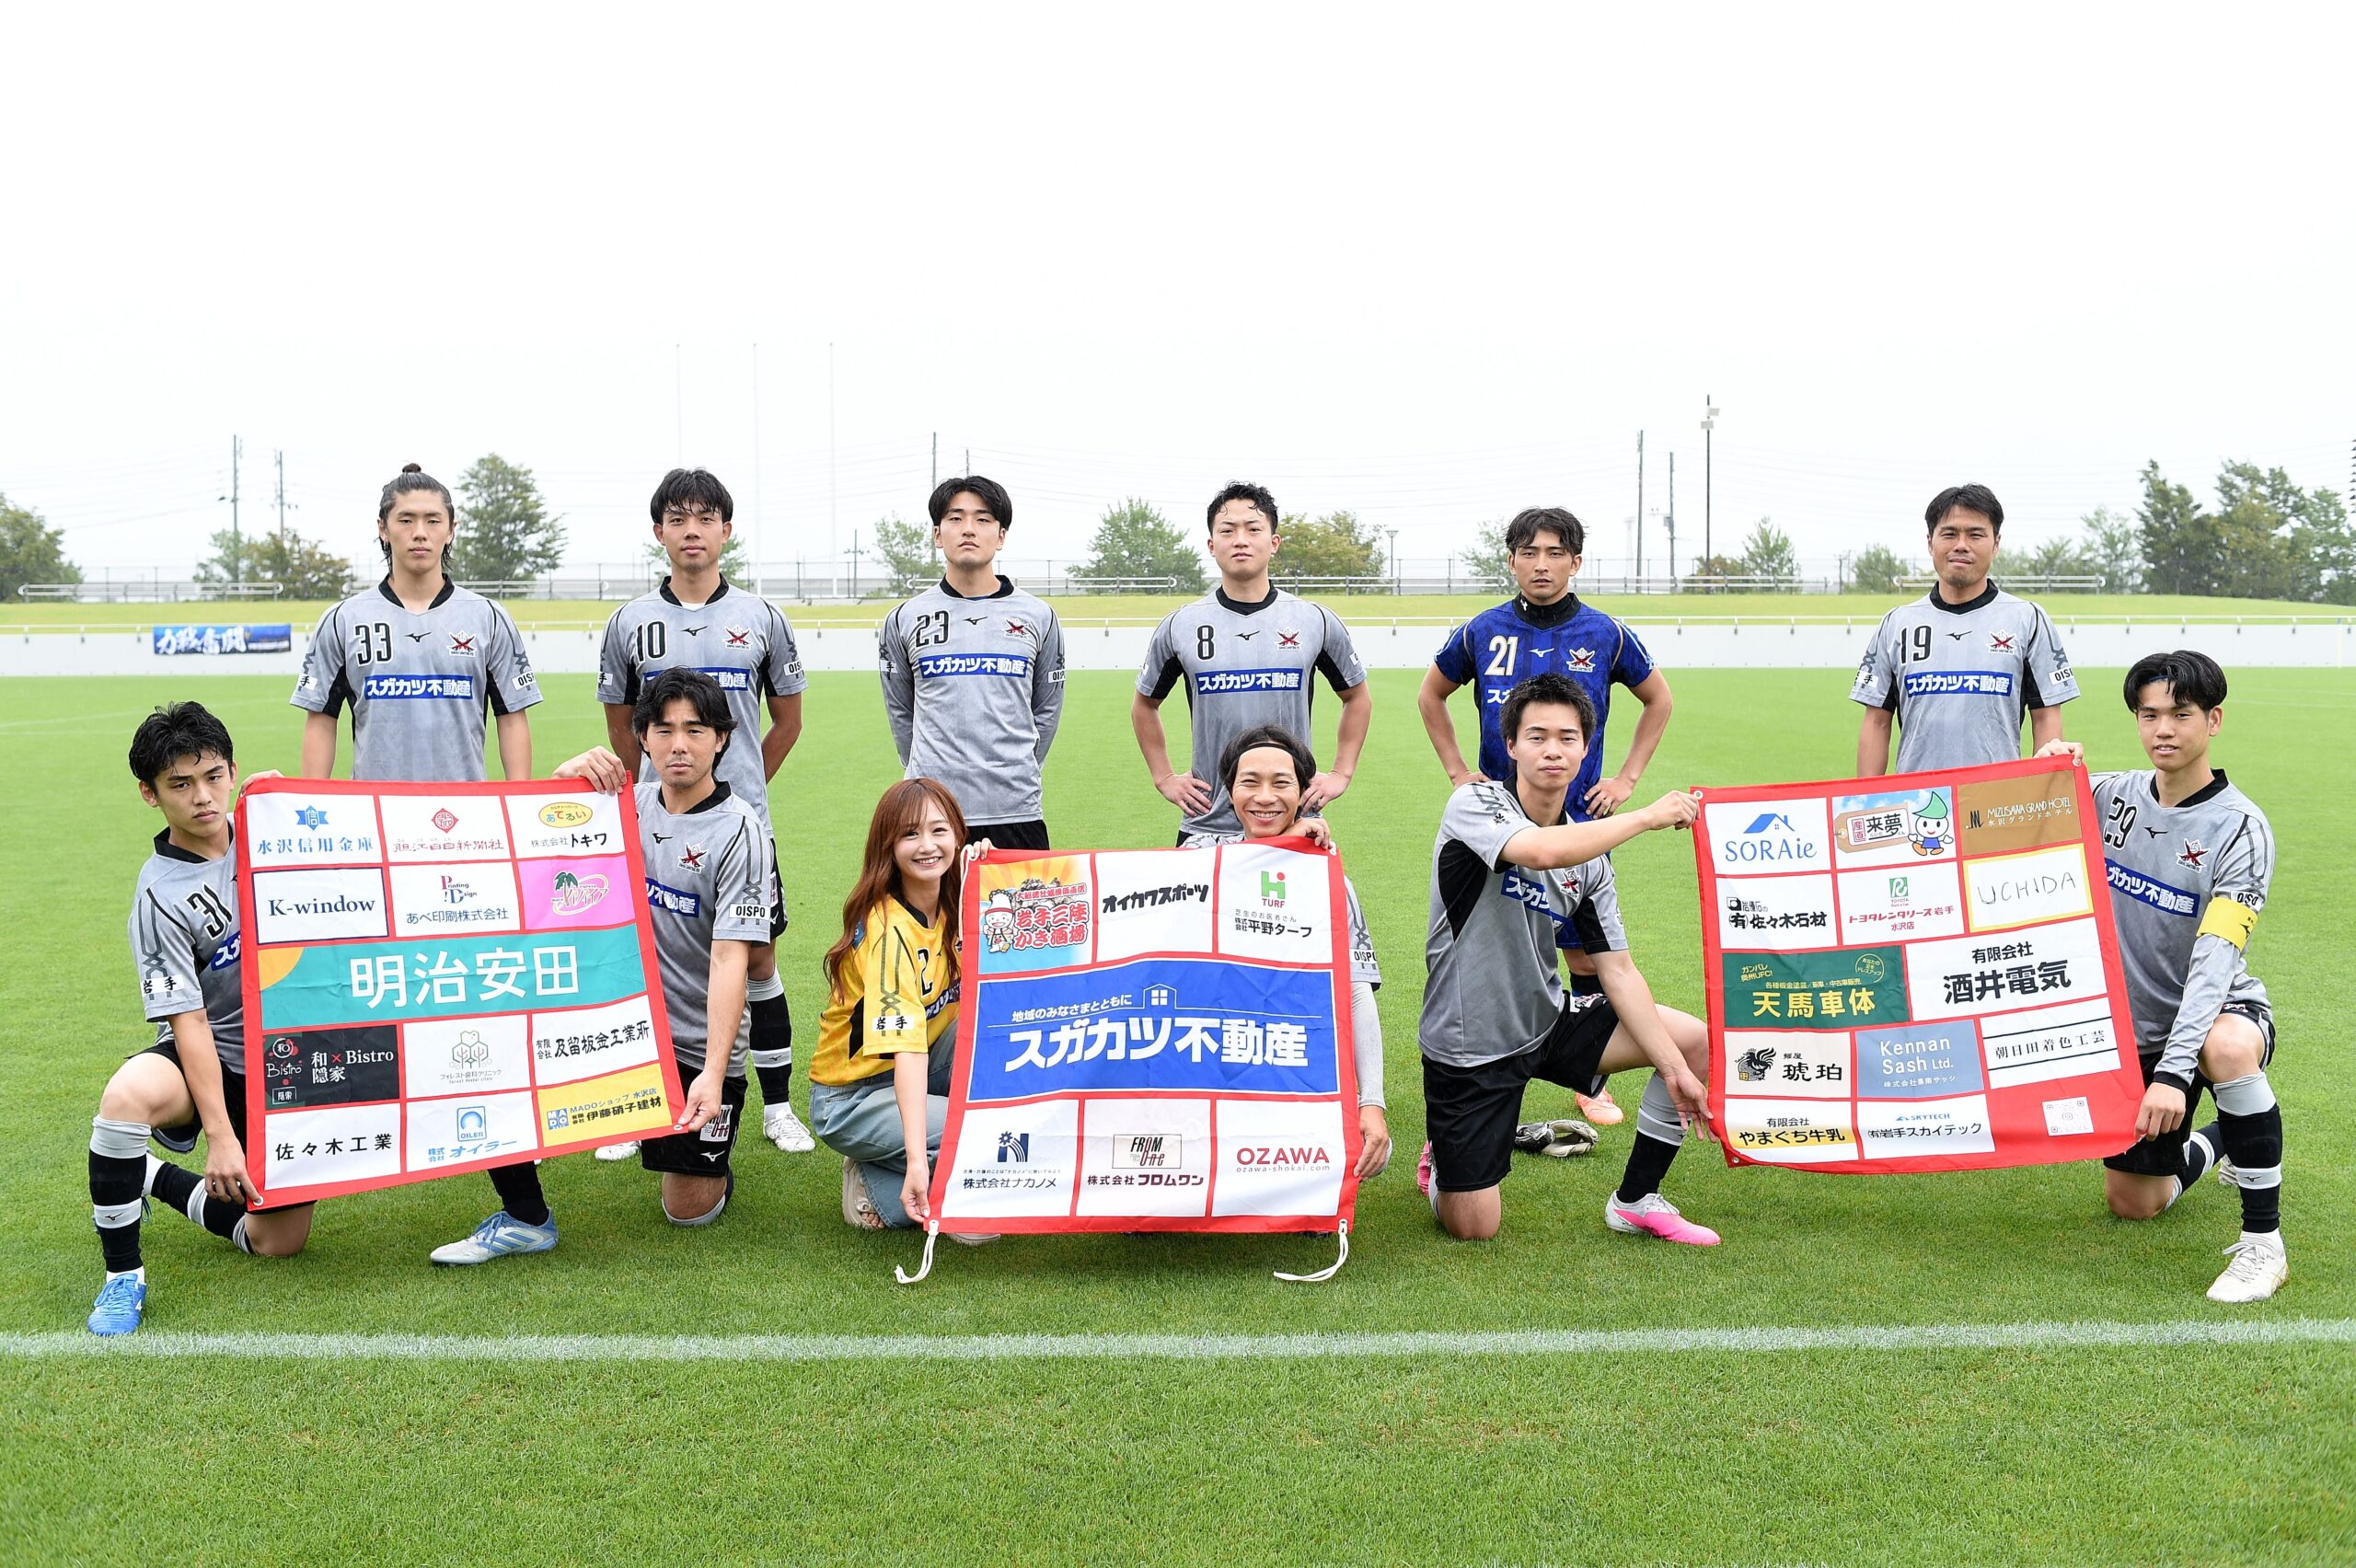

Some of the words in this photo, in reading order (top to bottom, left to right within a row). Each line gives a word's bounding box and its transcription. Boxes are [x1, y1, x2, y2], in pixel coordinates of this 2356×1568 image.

[916, 610, 949, 647] 23
[354, 622, 392, 664] 33
[637, 621, 666, 662] 10
[1197, 625, 1215, 660] 8
[1900, 625, 1931, 664] 19
[1484, 635, 1519, 676] 21
[789, 662, 803, 673] OIS
[921, 657, 1027, 675] スガカツ不動産
[367, 677, 472, 698] スガカツ不動産
[1198, 672, 1299, 691] スガカツ不動産
[1907, 674, 2010, 694] スガカツ不動産
[546, 811, 586, 823] あてるい
[1987, 804, 2025, 818] MIZUSAWA
[2026, 801, 2047, 813] GRAND
[2049, 797, 2072, 808] HOTEL
[1866, 813, 1903, 838] 来夢
[1988, 809, 2073, 826] 水沢グランドホテル
[2104, 796, 2137, 848] 29
[257, 836, 374, 855] 水沢信用金庫
[531, 836, 568, 847] 株式会社
[572, 833, 606, 847] トキワ
[1725, 838, 1818, 862] SORAie
[1977, 872, 2077, 905] UCHIDA
[2106, 864, 2195, 914] ガカツ不動産
[268, 897, 375, 917] K-window
[1103, 883, 1209, 914] オイカワスポーツ
[1262, 898, 1286, 908] TURF
[406, 907, 509, 924] あべ印刷株式会社
[735, 905, 766, 917] OISPO
[1016, 903, 1088, 928] 岩手三陸
[1849, 908, 1932, 923] トヨタレンタリース
[1934, 905, 1954, 916] 岩手
[1248, 919, 1311, 938] 平野ターフ
[1891, 922, 1914, 931] 水沢店
[1014, 924, 1086, 949] かき酒場
[1971, 941, 2034, 964] 有限会社
[349, 945, 579, 1009] 明治安田
[1741, 963, 1768, 974] ガンバレ
[143, 976, 177, 994] 岩手
[1943, 959, 2072, 1004] 酒井電気
[1012, 994, 1132, 1022] 地域のみなさまとともに
[1752, 987, 1876, 1019] 天馬車体
[876, 1016, 907, 1031] 岩手
[536, 1039, 551, 1049] 有限
[554, 1020, 650, 1058] 及留板金工業所
[1005, 1018, 1309, 1072] スガカツ不動産
[1880, 1038, 1951, 1057] Kennan
[1995, 1030, 2105, 1059] 朝日田着色工芸
[311, 1051, 328, 1068] 和
[345, 1049, 394, 1065] Bistro
[537, 1050, 552, 1060] 会社
[265, 1062, 302, 1078] Bistro
[1782, 1062, 1842, 1081] 琥珀
[1882, 1055, 1927, 1075] Sash
[1932, 1057, 1954, 1070] Ltd.
[312, 1066, 346, 1084] 隠家
[633, 1088, 657, 1100] 水沢店
[586, 1096, 662, 1122] 伊藤硝子建材
[1766, 1118, 1810, 1128] 有限会社
[460, 1131, 484, 1139] OILER
[1130, 1136, 1163, 1153] FROM
[1738, 1128, 1845, 1146] やまぐち牛乳
[276, 1134, 393, 1161] 佐々木工業
[449, 1140, 517, 1158] オイラー
[1236, 1147, 1330, 1165] OZAWA
[1139, 1151, 1165, 1166] One
[1236, 1164, 1330, 1173] ozawa-shokai.com
[963, 1178, 1057, 1189] 株式会社ナカノメ
[1087, 1175, 1135, 1185] 株式会社
[1138, 1174, 1204, 1186] フロムワン
